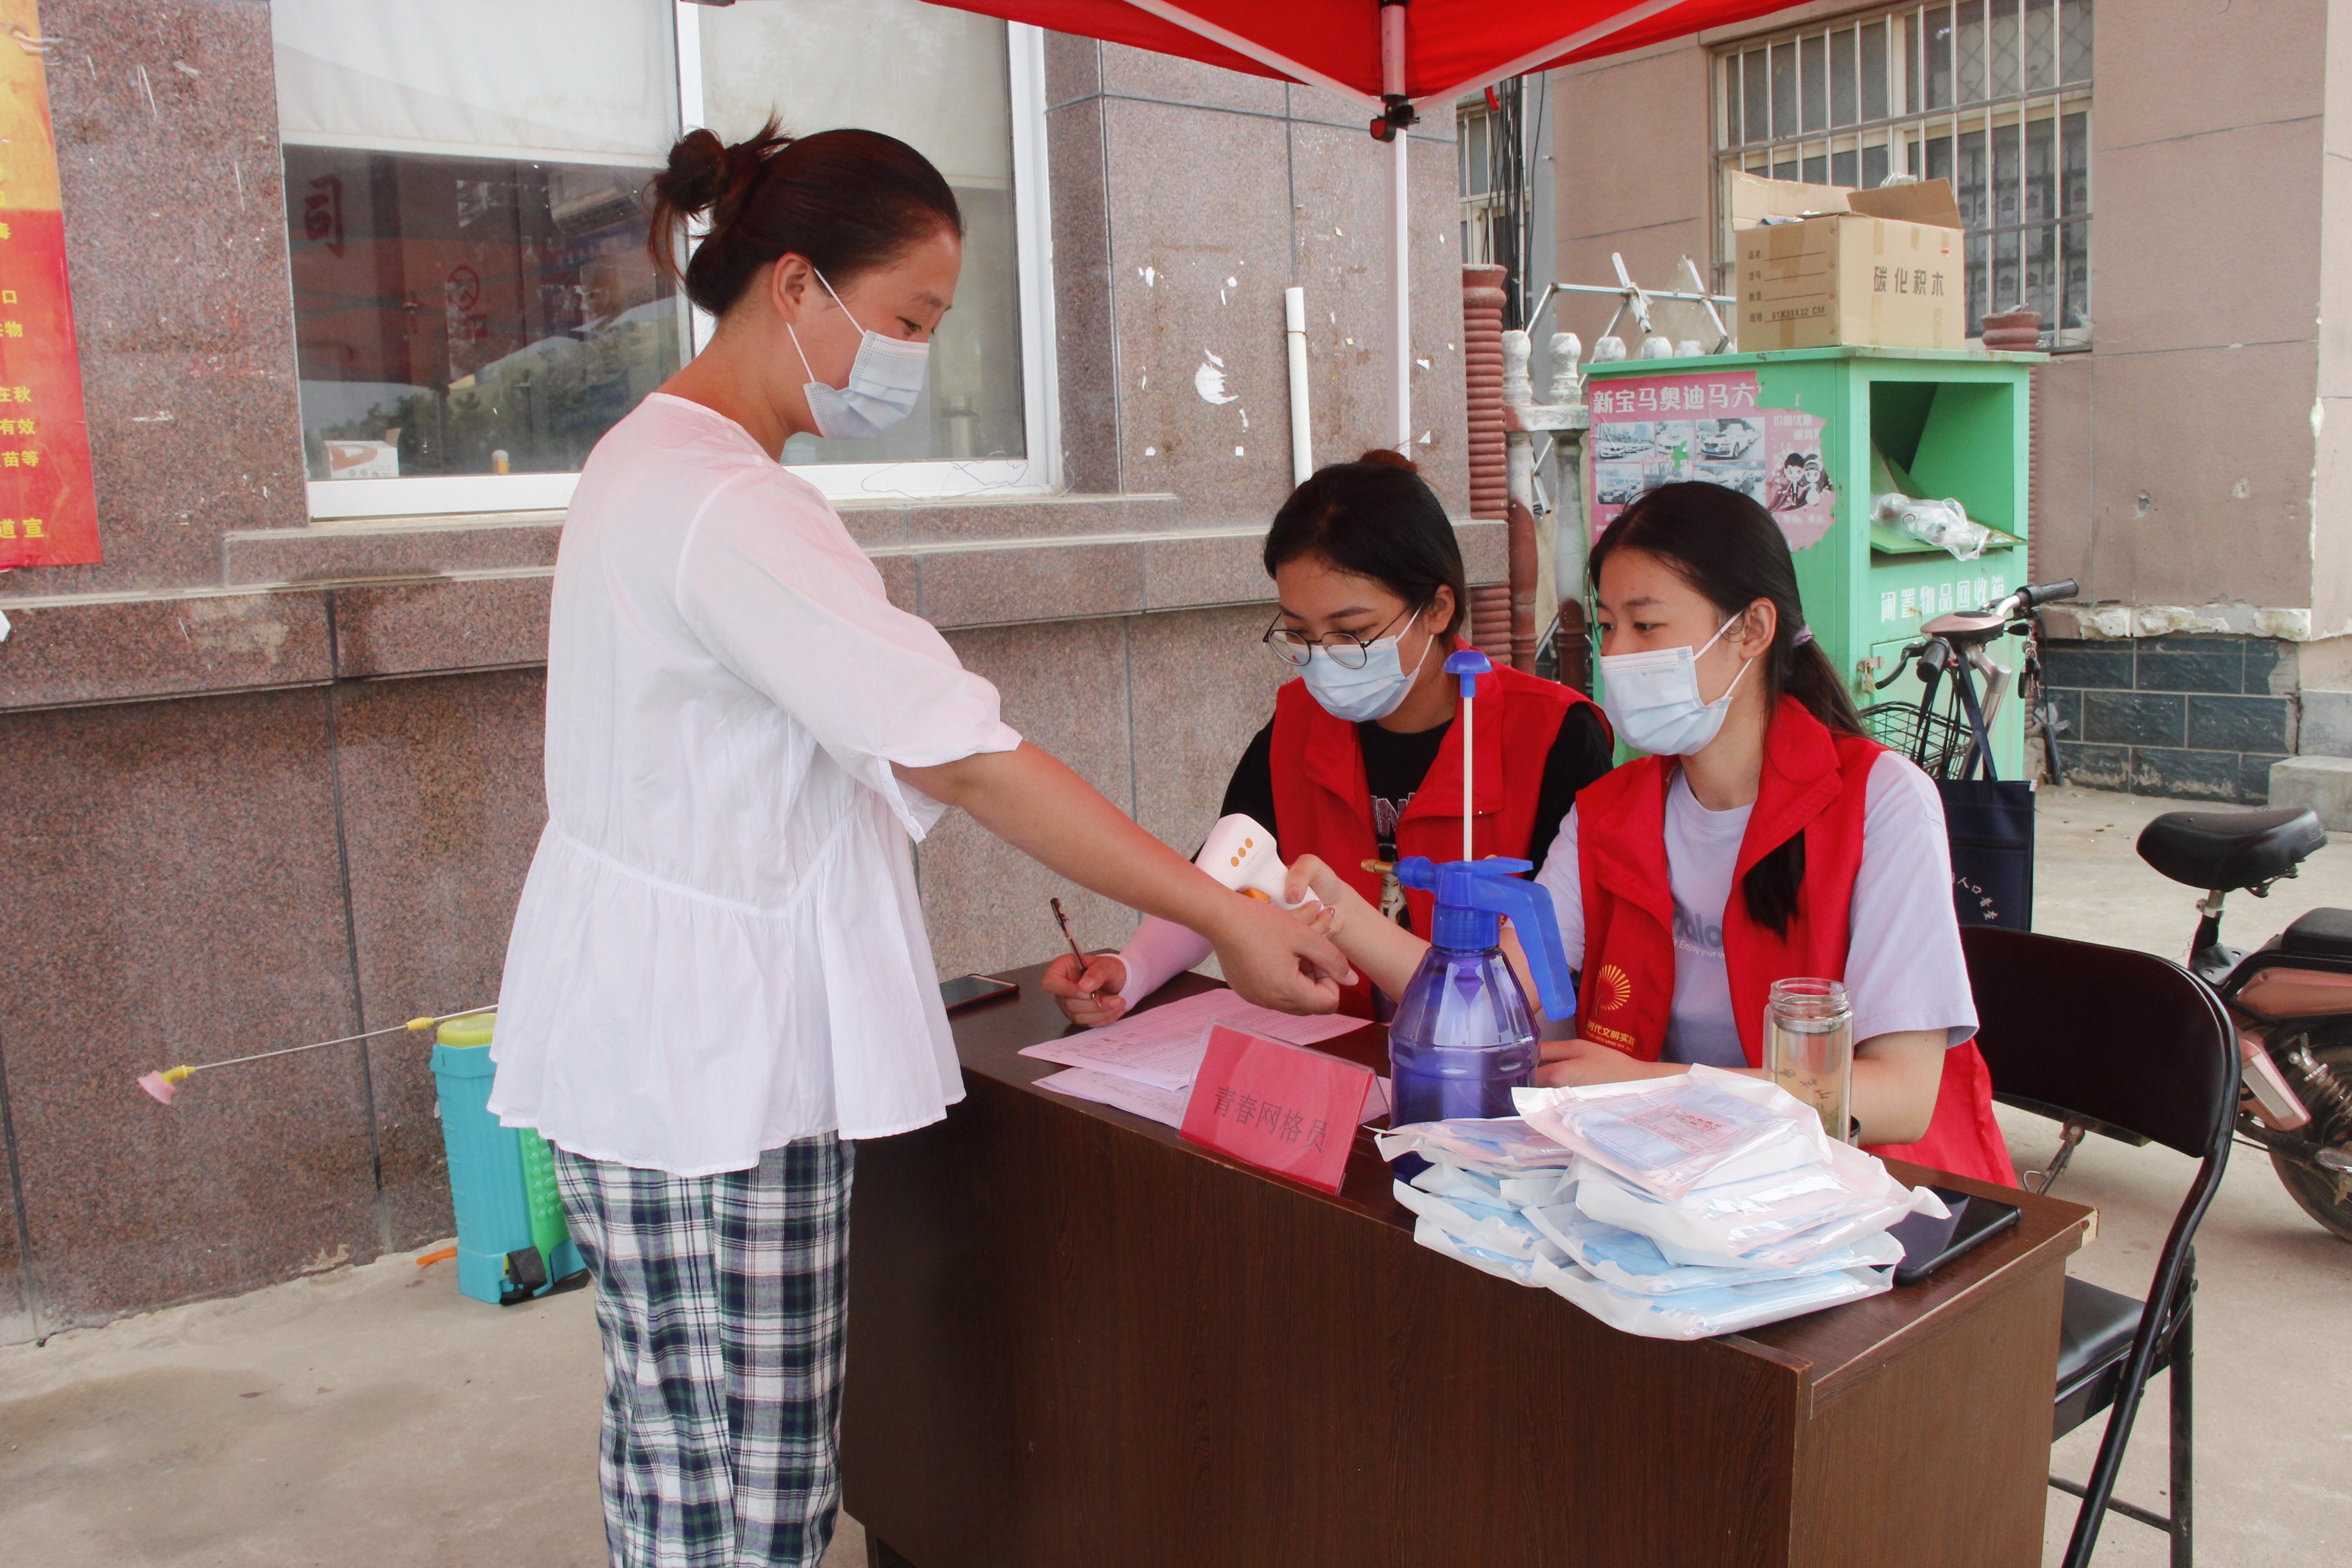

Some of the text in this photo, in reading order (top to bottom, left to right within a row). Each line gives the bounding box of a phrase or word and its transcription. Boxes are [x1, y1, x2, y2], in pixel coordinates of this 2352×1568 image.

[1874, 266, 1944, 296] 碳化积木
[1812, 306, 1825, 314] CM
[0, 321, 23, 338] 物
[1593, 382, 1761, 414] 新宝马奥迪马六
[0, 418, 36, 435] 有效
[0, 451, 39, 468] 苗等
[1882, 575, 2004, 622] 闲置物品回收箱
[1952, 872, 1998, 920] 人口普查
[1214, 1086, 1328, 1153] 青春网格员
